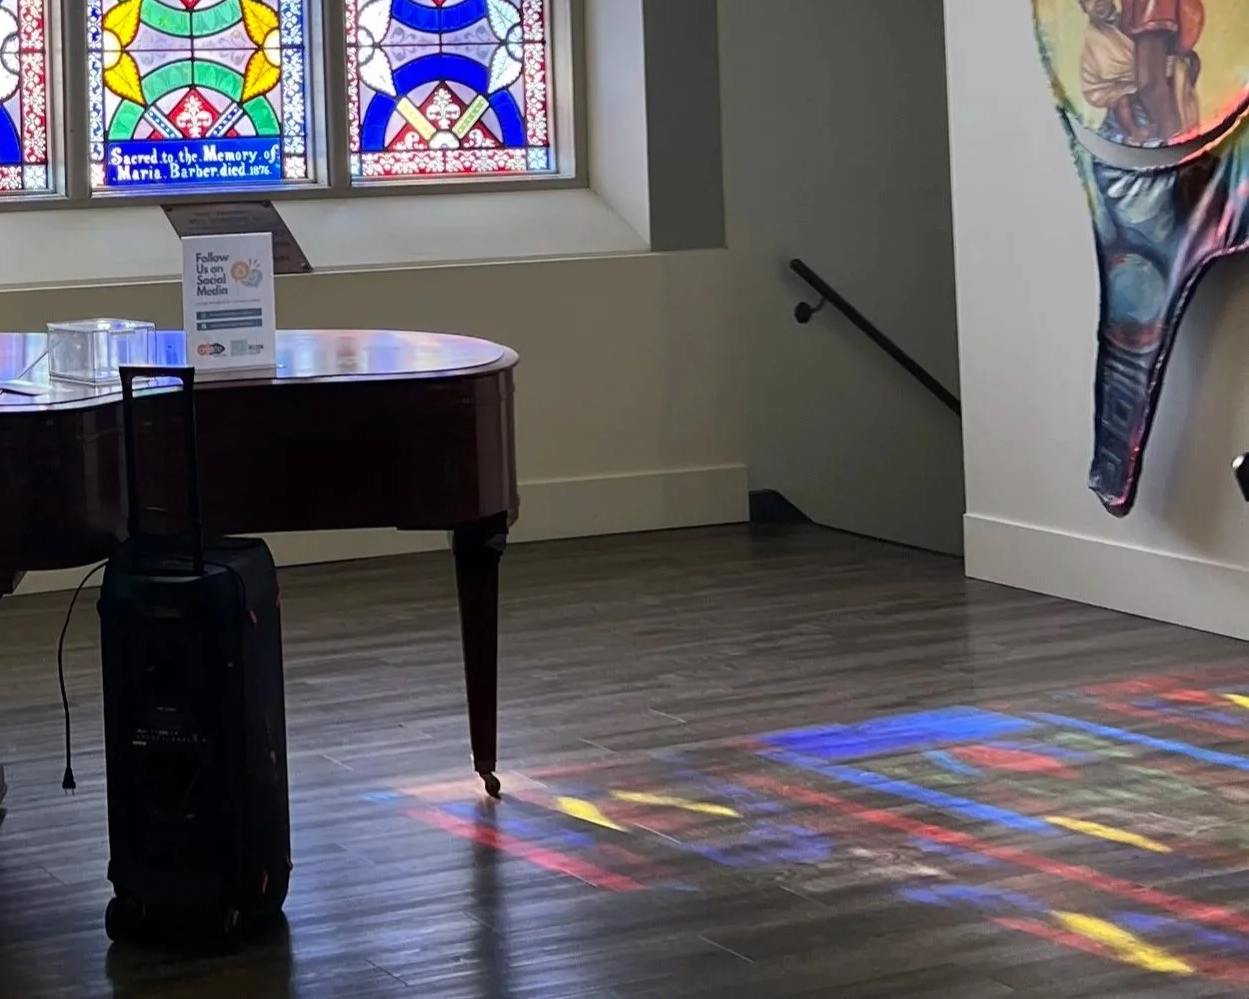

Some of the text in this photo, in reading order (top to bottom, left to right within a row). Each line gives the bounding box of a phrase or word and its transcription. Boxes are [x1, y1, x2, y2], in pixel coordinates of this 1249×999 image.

[111, 144, 279, 165] Sacred to the Memory of
[117, 165, 162, 181] Maria
[170, 163, 218, 178] Barber
[219, 161, 246, 177] died
[196, 252, 229, 263] Follow
[196, 264, 209, 274] Us
[197, 273, 226, 285] Social
[197, 286, 228, 296] Media
